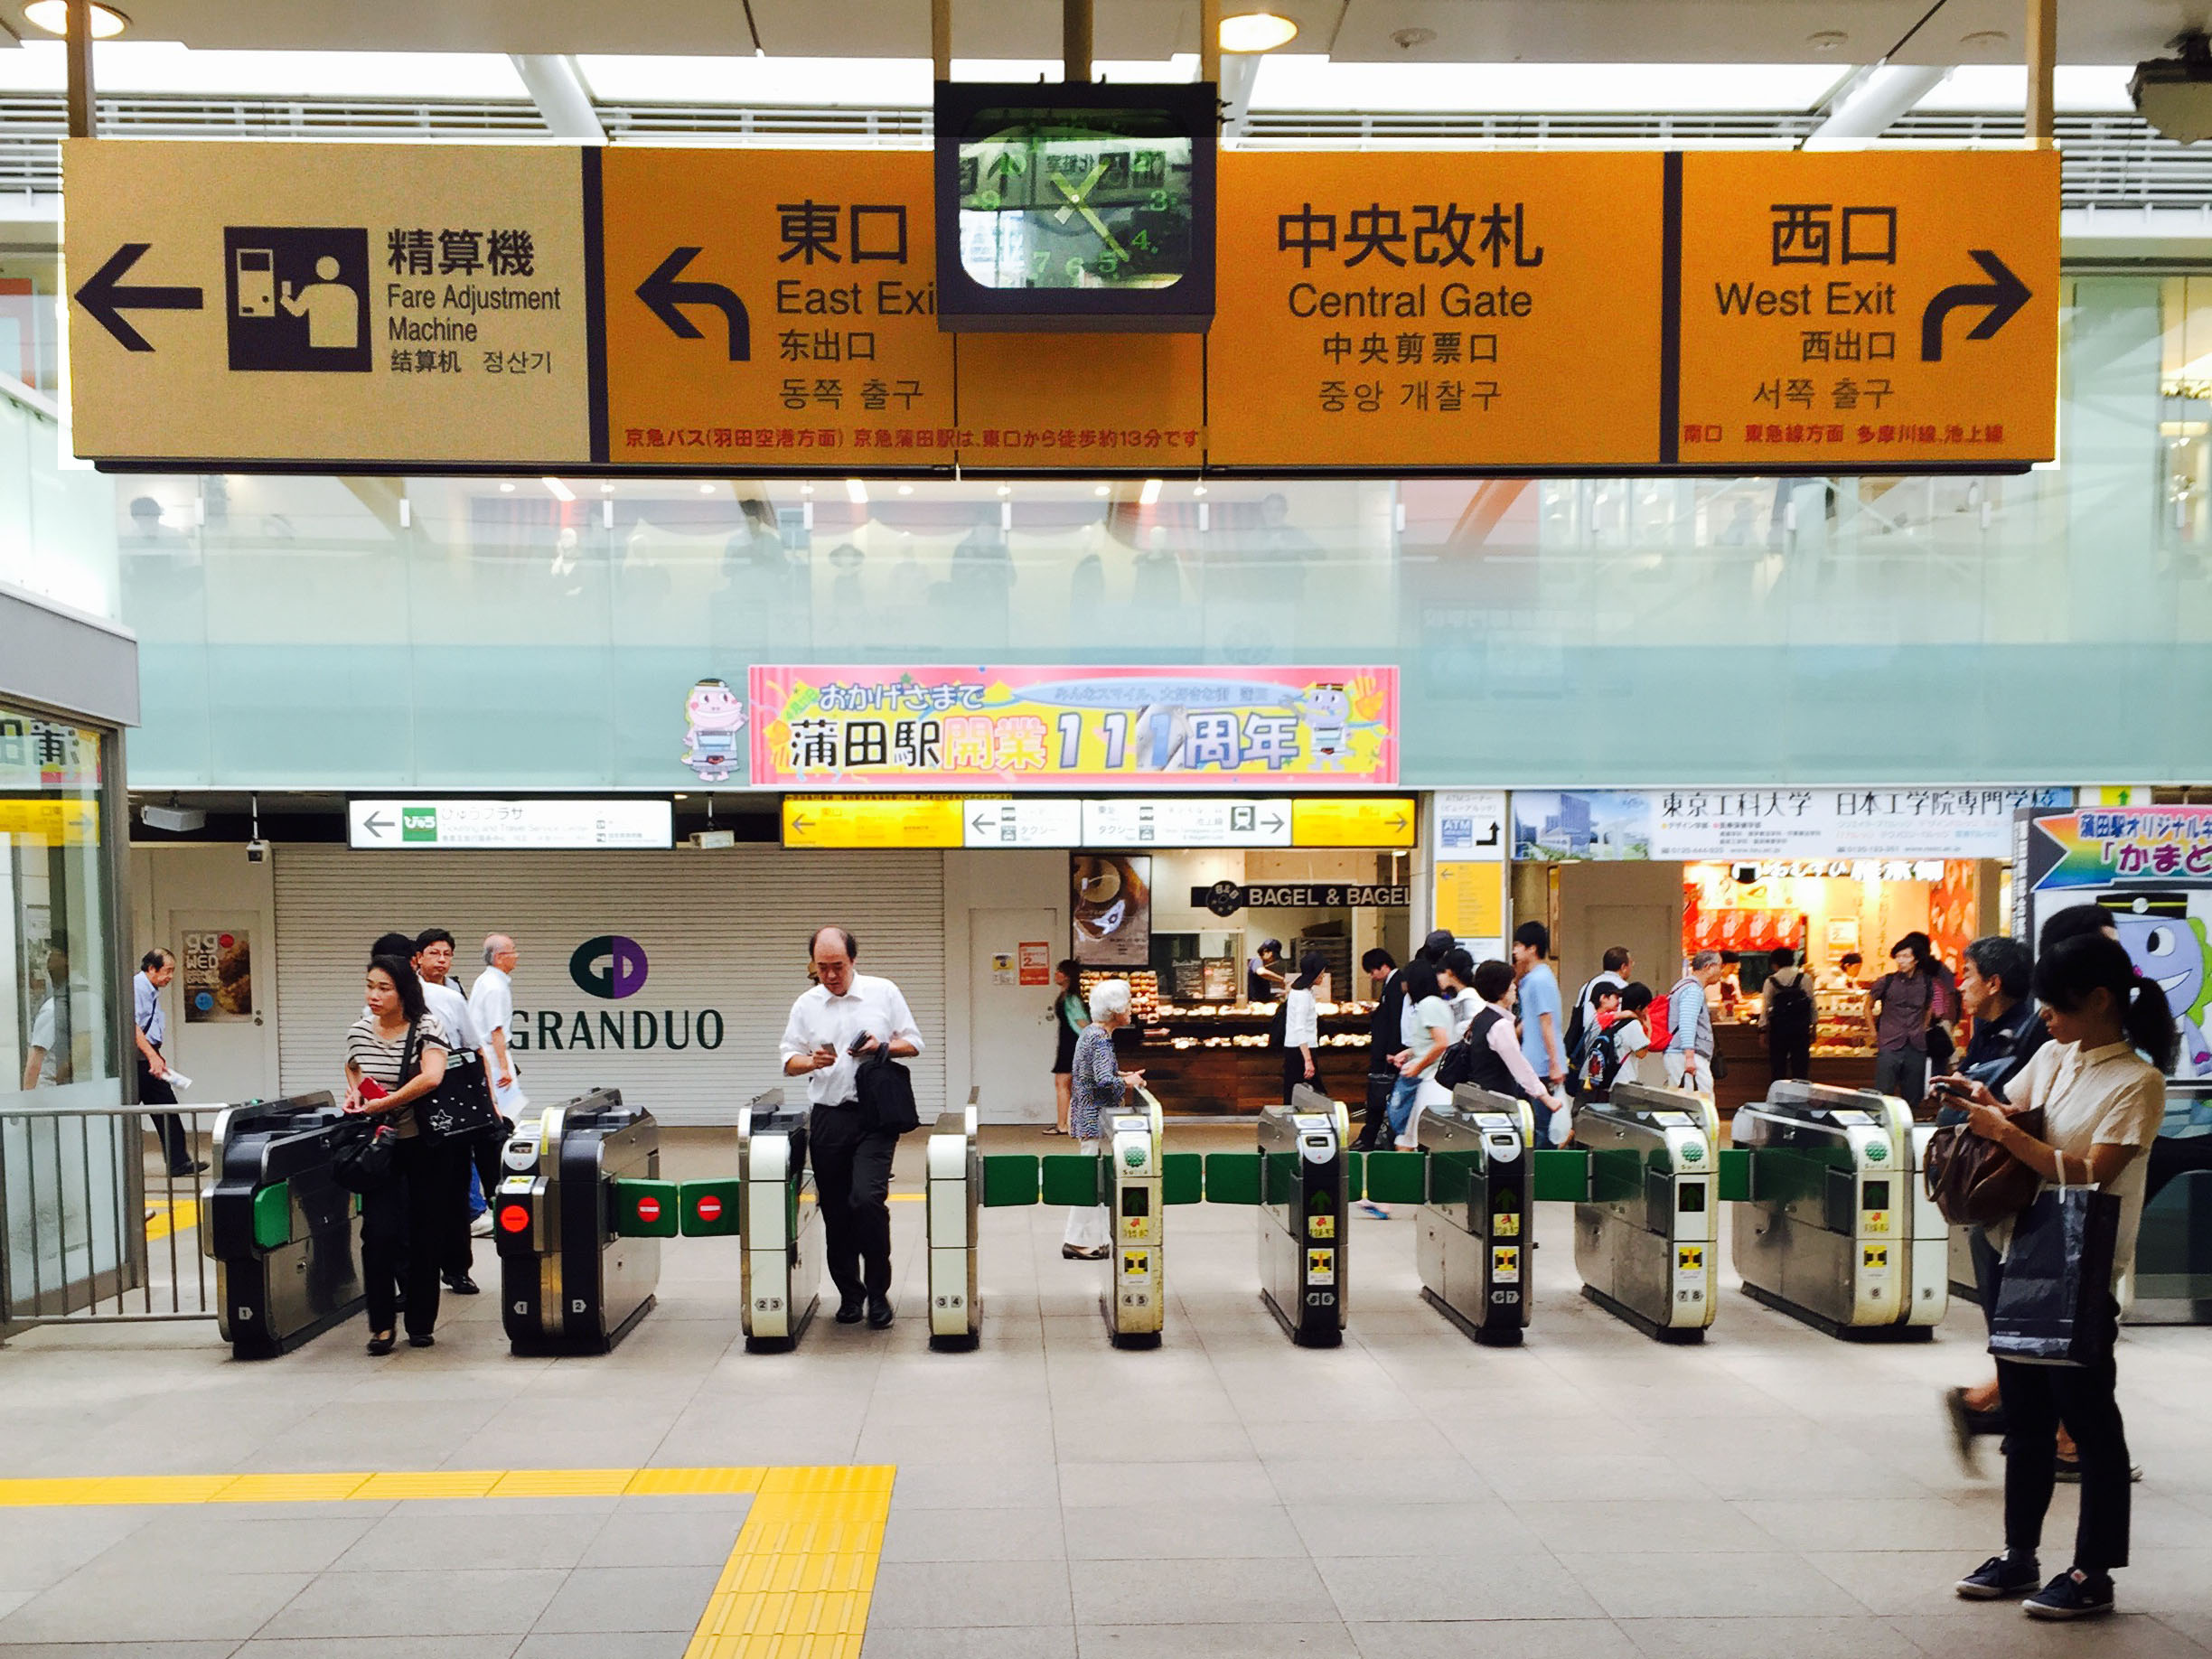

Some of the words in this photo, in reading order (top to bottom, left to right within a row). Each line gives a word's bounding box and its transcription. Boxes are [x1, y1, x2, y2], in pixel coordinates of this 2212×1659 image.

[1150, 190, 1167, 211] 3
[776, 199, 908, 265] 東口
[1132, 229, 1149, 251] 4
[1277, 203, 1543, 269] 中央改札
[1769, 204, 1898, 267] 西口
[388, 229, 535, 276] 精算機
[1033, 251, 1051, 274] 7
[1099, 250, 1118, 273] 5
[388, 284, 438, 309] Fare
[443, 284, 561, 314] Adjustment
[776, 283, 862, 314] East
[878, 283, 937, 314] Exi
[1288, 283, 1426, 319] Central
[1439, 283, 1532, 319] Gate
[1715, 283, 1811, 316] West
[1827, 283, 1896, 316] Exit
[389, 317, 477, 342] Machine
[779, 329, 875, 362] 东出口
[1324, 332, 1498, 364] 中央剪票口
[1802, 331, 1896, 362] 西出口
[390, 350, 462, 374] 结算机
[483, 350, 551, 374] 정산기
[780, 378, 843, 411] 동쪽
[860, 378, 924, 411] 출구
[1318, 380, 1383, 413] 중앙
[1400, 380, 1502, 413] 개찰구
[1753, 378, 1815, 411] 서쪽
[1831, 378, 1894, 411] 출구
[818, 682, 985, 712] おかげさまで
[1662, 792, 1812, 817] 東京工科大学
[1836, 791, 2056, 816] 日本工学院専門学校
[1444, 820, 1471, 830] ATM
[1249, 887, 1319, 905] BAGEL
[1326, 888, 1340, 904] &
[186, 954, 218, 970] WED
[510, 1009, 724, 1050] GRANDUO
